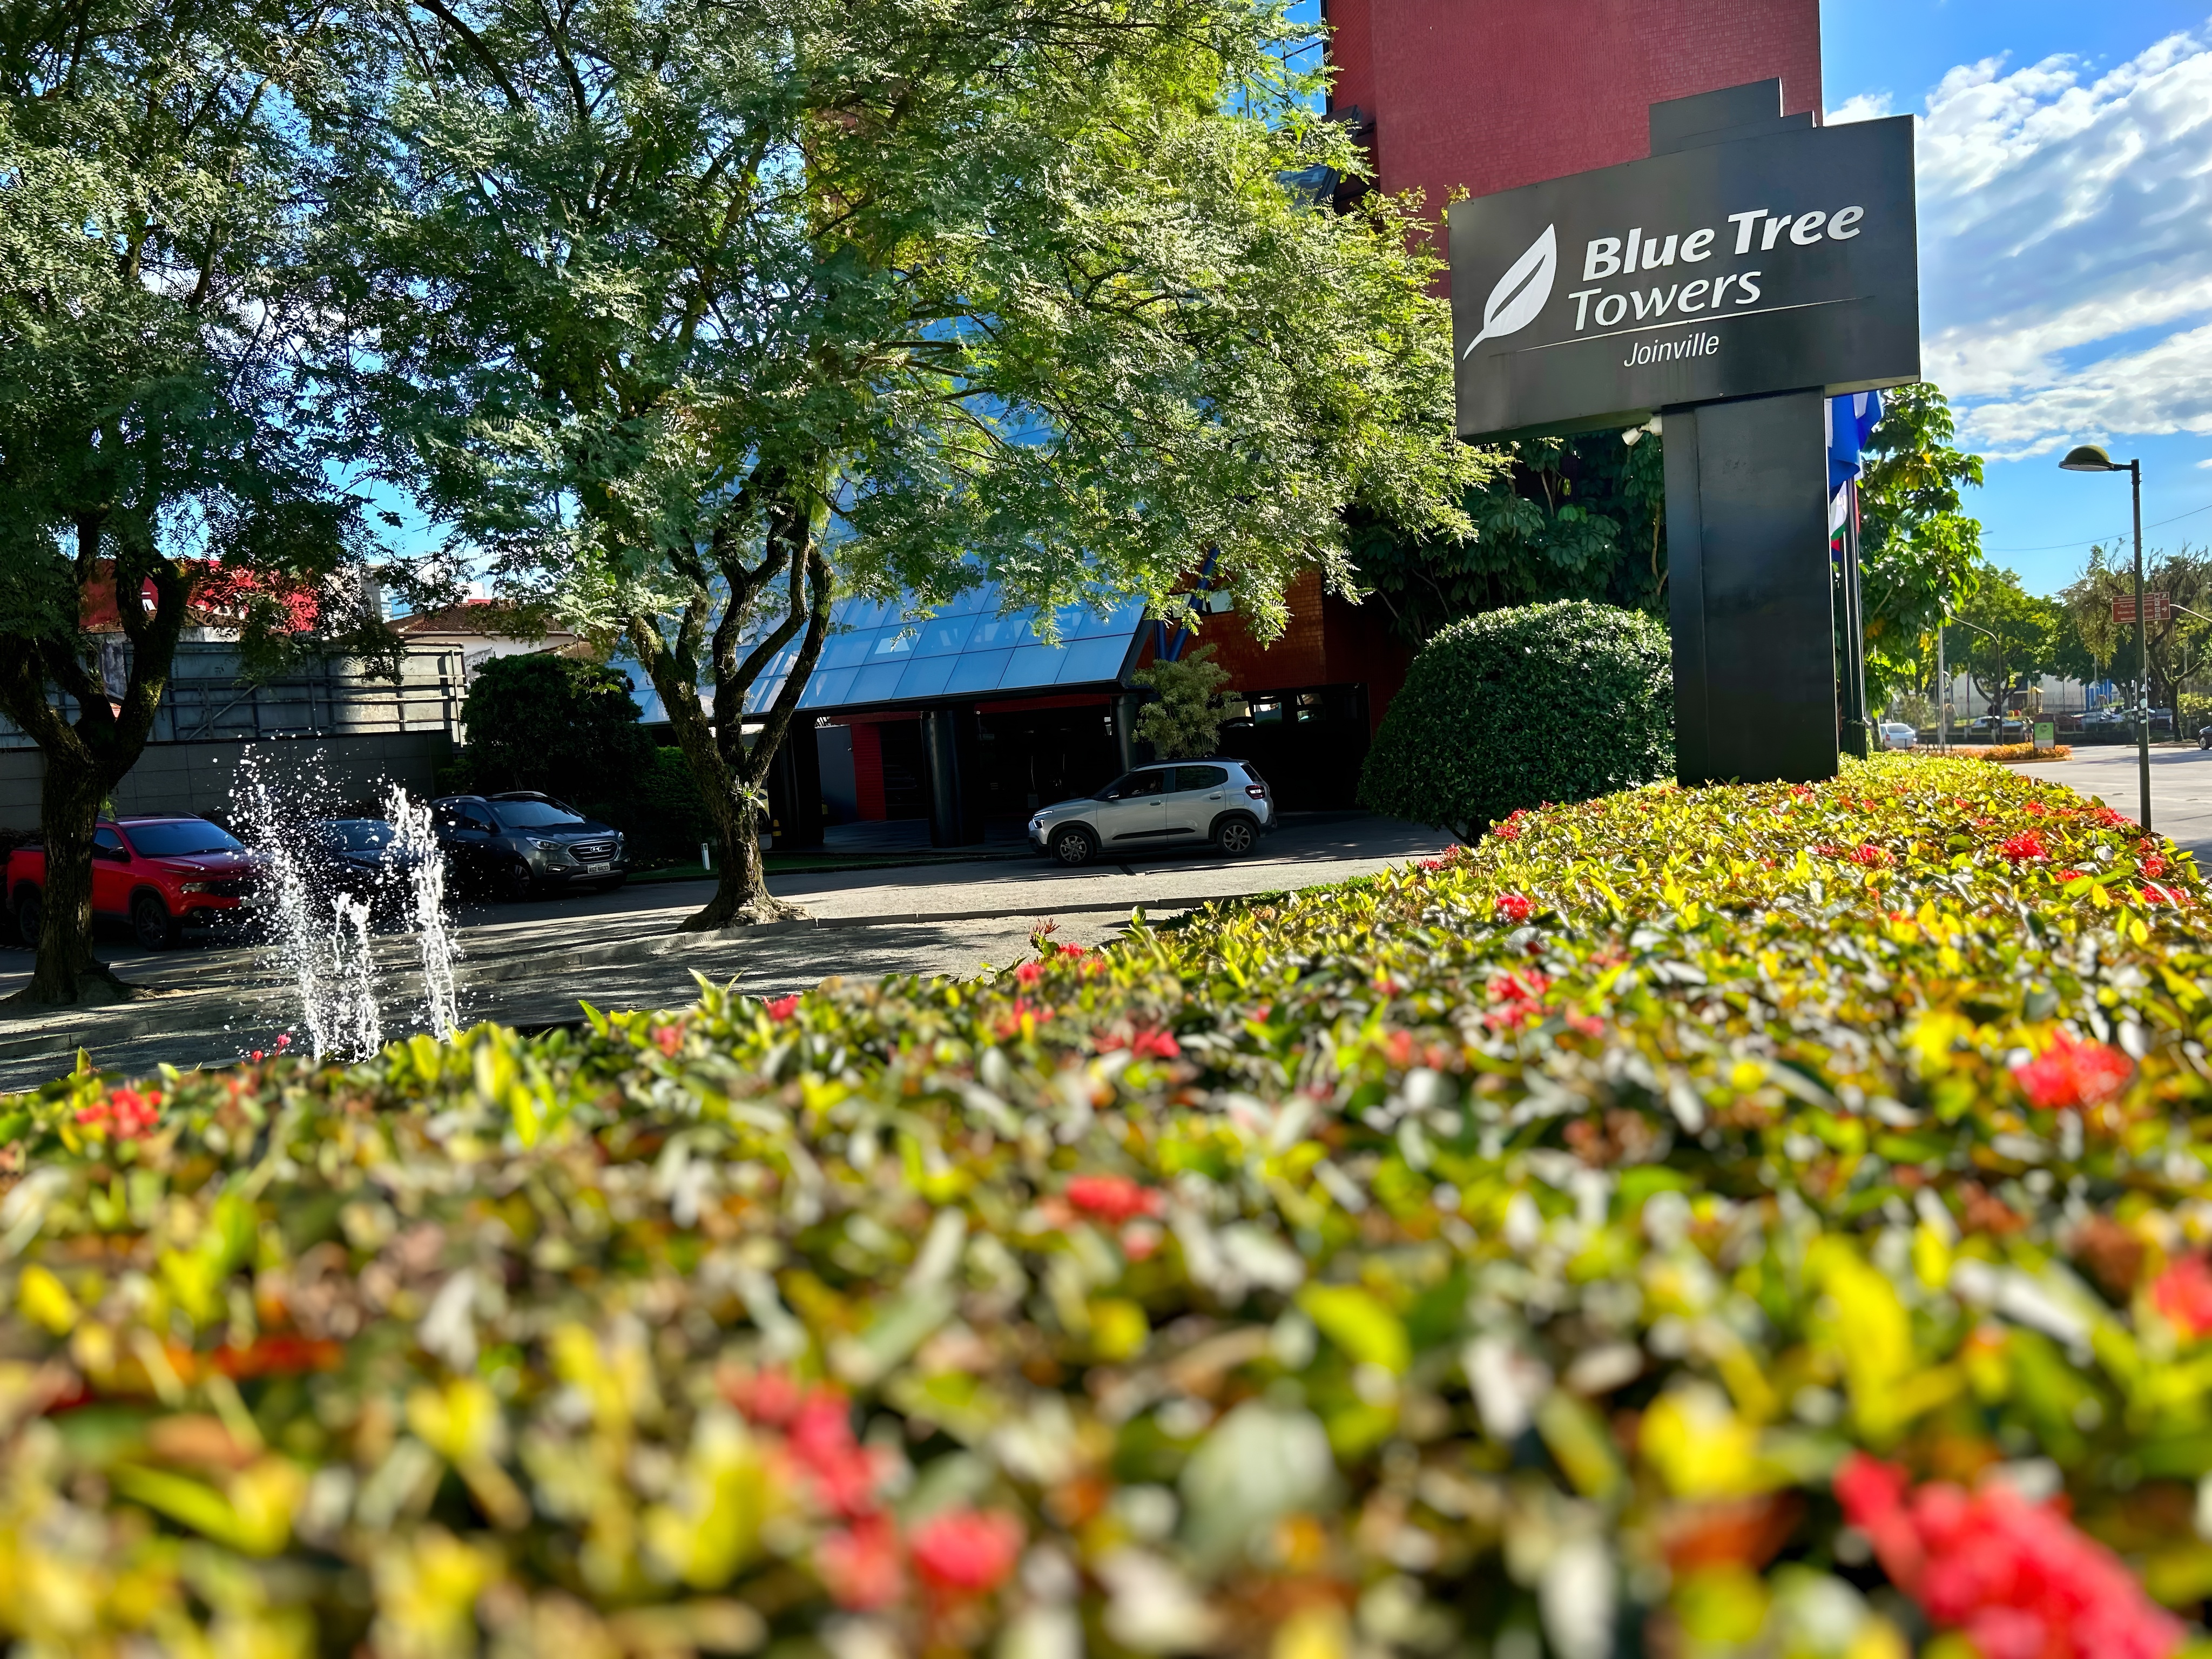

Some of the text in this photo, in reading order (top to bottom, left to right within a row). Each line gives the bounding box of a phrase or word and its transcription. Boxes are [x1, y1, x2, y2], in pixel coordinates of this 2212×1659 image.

[1582, 206, 1864, 281] Blue Tree
[1568, 271, 1762, 331] Towers
[1623, 332, 1719, 367] Joinville
